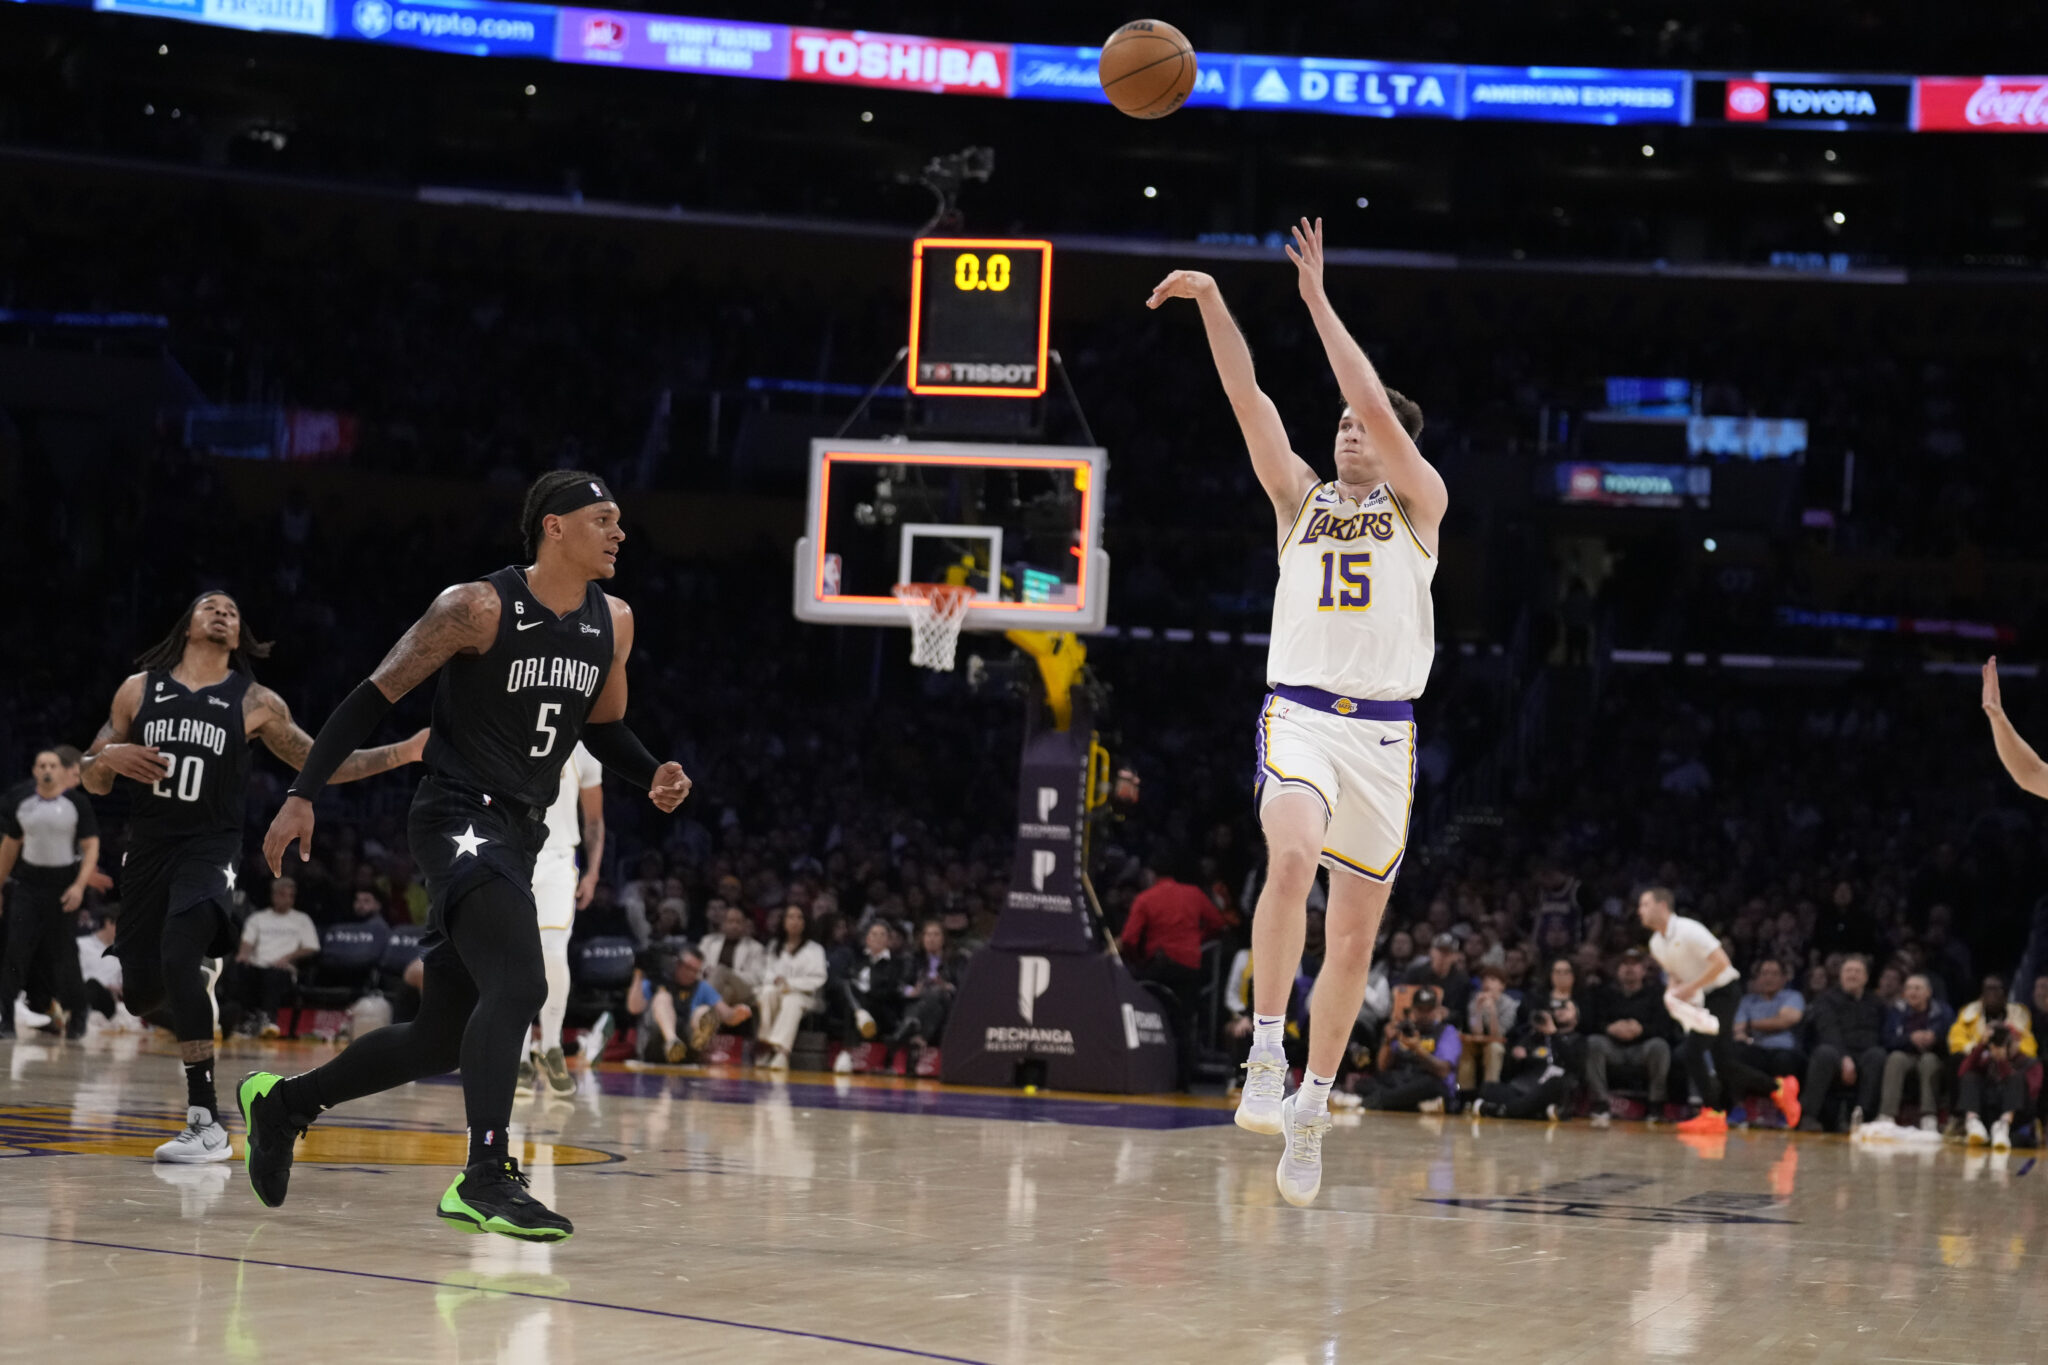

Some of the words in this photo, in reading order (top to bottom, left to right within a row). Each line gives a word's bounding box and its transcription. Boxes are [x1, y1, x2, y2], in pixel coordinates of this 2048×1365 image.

[394, 9, 535, 42] crypto.com
[796, 36, 1002, 89] TOSHIBA
[1300, 70, 1446, 107] DELTA
[1473, 83, 1579, 106] AMERICAN
[1581, 85, 1675, 108] EXPRESS
[1773, 89, 1877, 115] TOYOTA
[954, 253, 1011, 292] 0.0
[953, 364, 1037, 383] TISSOT
[1603, 474, 1674, 494] TOYOTA
[1363, 495, 1388, 509] bibigo
[1298, 508, 1394, 545] LAKERS
[1317, 551, 1372, 612] 15
[514, 601, 524, 615] 6
[506, 657, 599, 697] ORLANDO
[144, 718, 227, 756] ORLANDO
[530, 702, 562, 757] 5
[152, 751, 205, 802] 20
[1008, 891, 1072, 906] PECHANGA
[985, 1027, 1074, 1044] PECHANGA
[985, 1042, 1029, 1052] RESORT
[1032, 1042, 1075, 1055] CASINO
